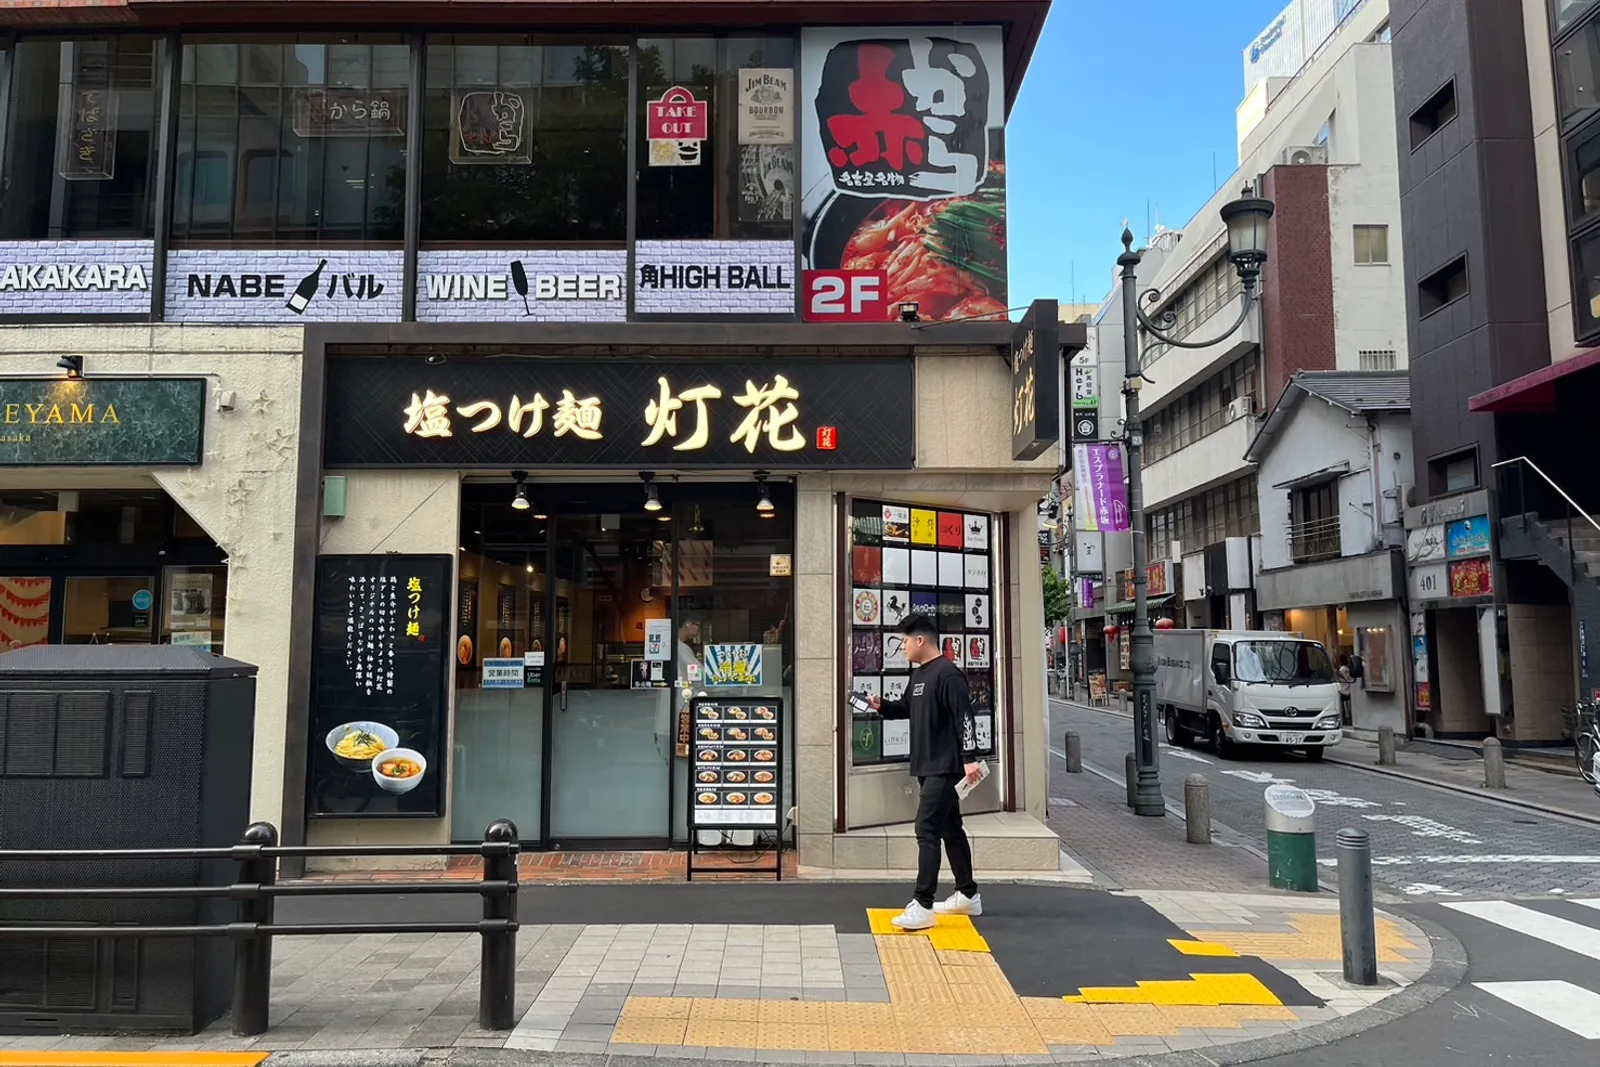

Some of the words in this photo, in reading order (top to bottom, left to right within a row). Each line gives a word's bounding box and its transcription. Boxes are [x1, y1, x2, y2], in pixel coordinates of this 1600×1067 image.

[762, 74, 787, 92] BEAM
[655, 106, 697, 118] TAKE
[748, 106, 784, 115] BOURBON
[661, 122, 693, 134] OUT
[187, 274, 285, 298] NABE
[326, 273, 385, 299] バル
[426, 274, 508, 299] WINE
[536, 274, 621, 299] BEER
[727, 264, 791, 290] BALL
[811, 275, 880, 314] 2F
[5, 403, 120, 424] EYAMA
[402, 388, 604, 440] 塩つけ麺
[639, 373, 807, 454] 灯花
[1420, 574, 1437, 591] 401
[406, 576, 423, 637] 塩つけ麺
